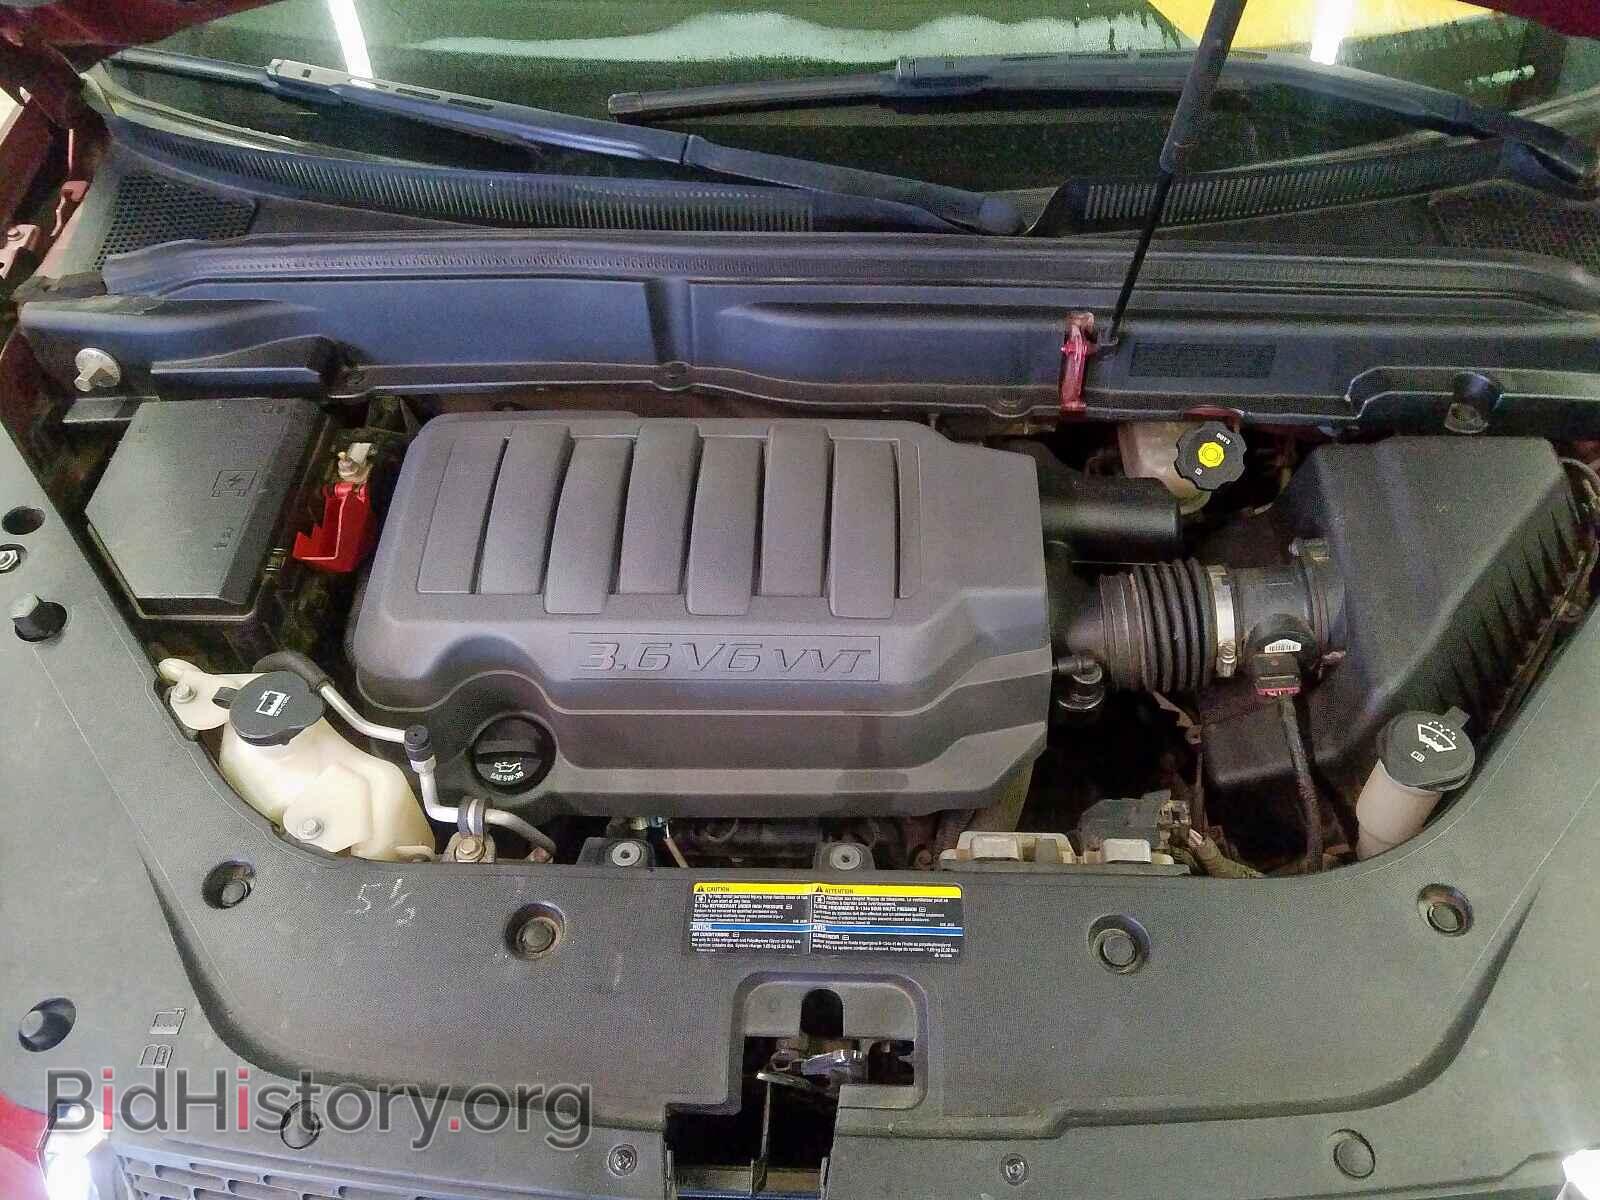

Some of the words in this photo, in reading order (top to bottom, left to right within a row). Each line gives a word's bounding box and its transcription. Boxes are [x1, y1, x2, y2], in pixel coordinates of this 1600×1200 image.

[579, 642, 672, 671] 3.6
[680, 643, 763, 672] V6
[773, 648, 871, 673] VVT
